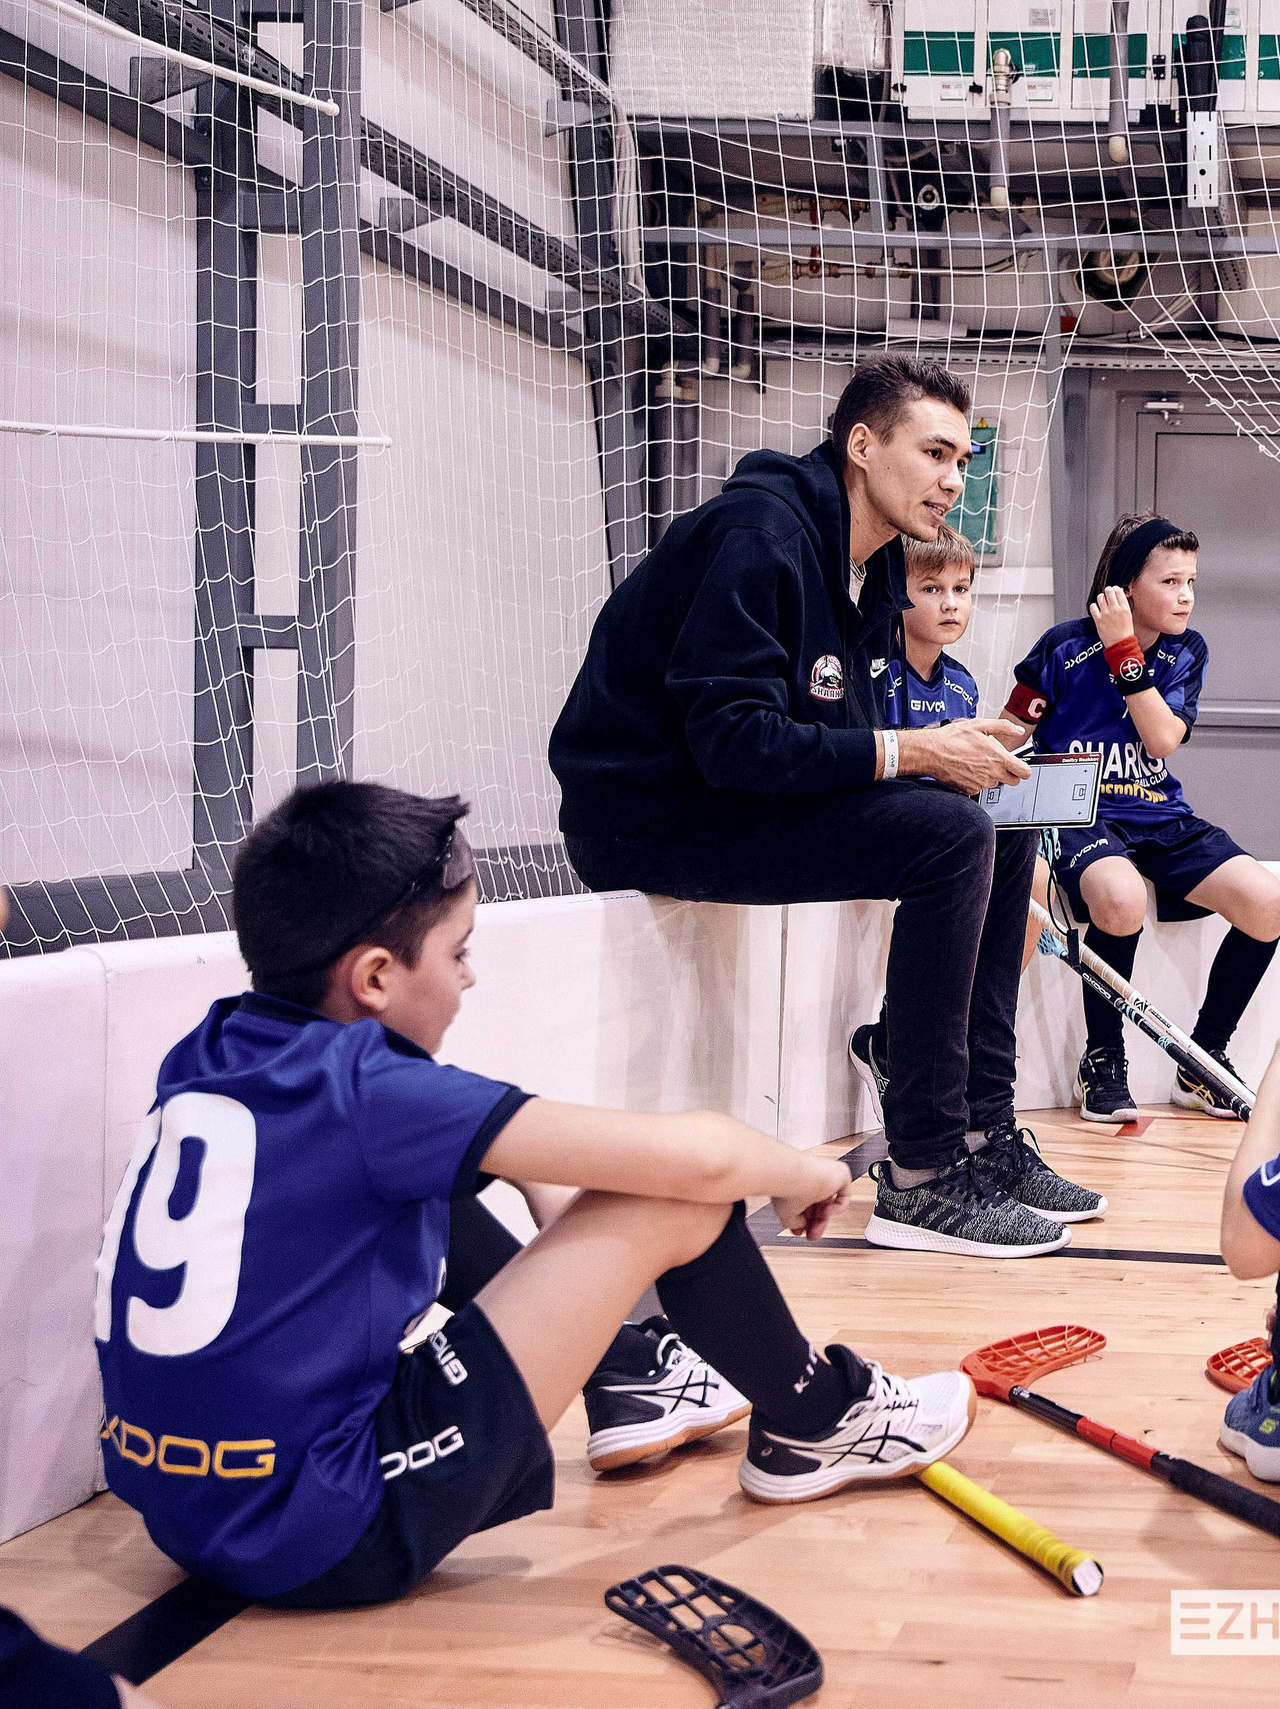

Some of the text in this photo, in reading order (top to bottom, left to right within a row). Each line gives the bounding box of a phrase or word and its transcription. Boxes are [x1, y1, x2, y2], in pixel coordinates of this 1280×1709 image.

[911, 699, 946, 713] GIVOA
[1027, 697, 1047, 719] C
[1069, 838, 1109, 869] GIVOVA
[96, 1091, 257, 1357] 9
[101, 1415, 276, 1479] DOG
[380, 1425, 465, 1480] DOG
